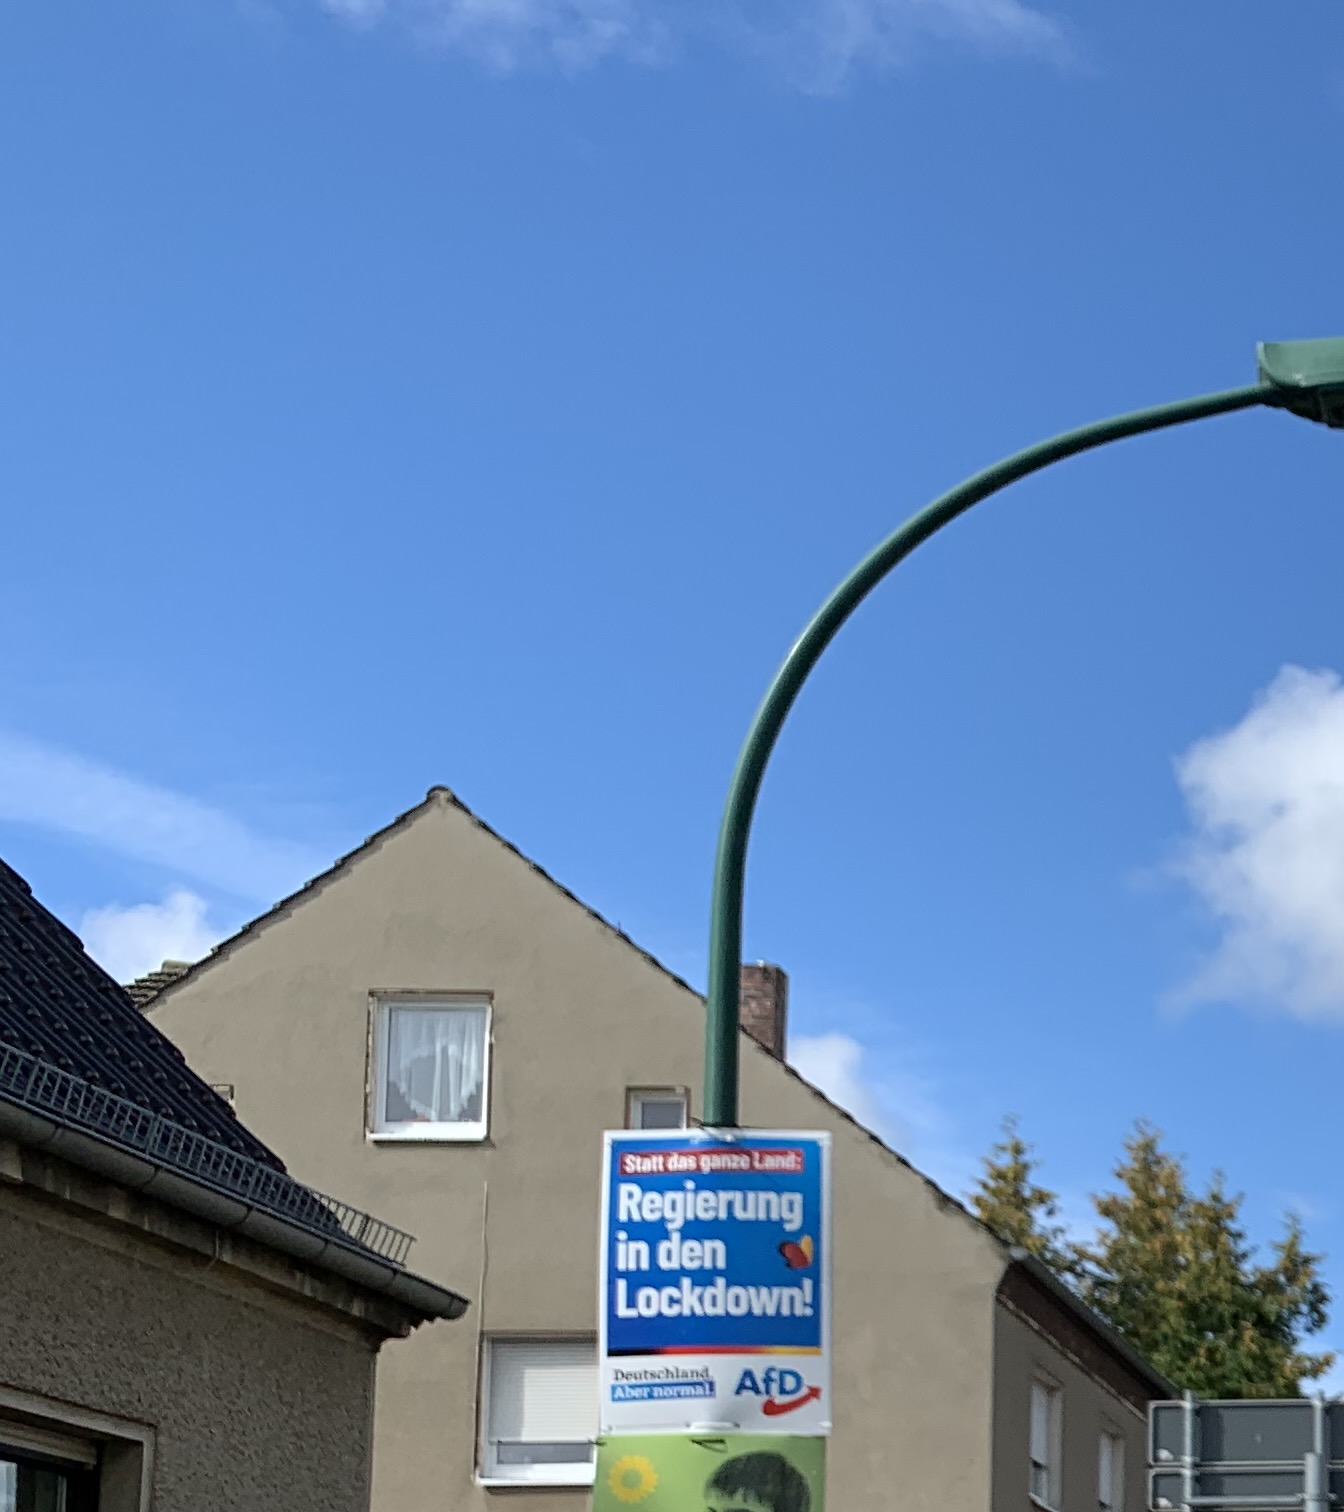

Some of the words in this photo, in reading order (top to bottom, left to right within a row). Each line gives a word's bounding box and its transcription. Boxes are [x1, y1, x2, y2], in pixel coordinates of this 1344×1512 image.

[624, 1153, 665, 1173] Statt
[667, 1151, 697, 1170] das
[701, 1152, 750, 1175] ganze
[752, 1150, 802, 1170] Land:
[617, 1179, 804, 1232] Regierung
[615, 1231, 650, 1271] in
[657, 1231, 727, 1270] den
[615, 1277, 814, 1319] Lockdown!
[613, 1366, 714, 1382] Deutschland.
[734, 1366, 804, 1397] AfD
[613, 1384, 648, 1400] Aber
[653, 1383, 714, 1398] normal.
